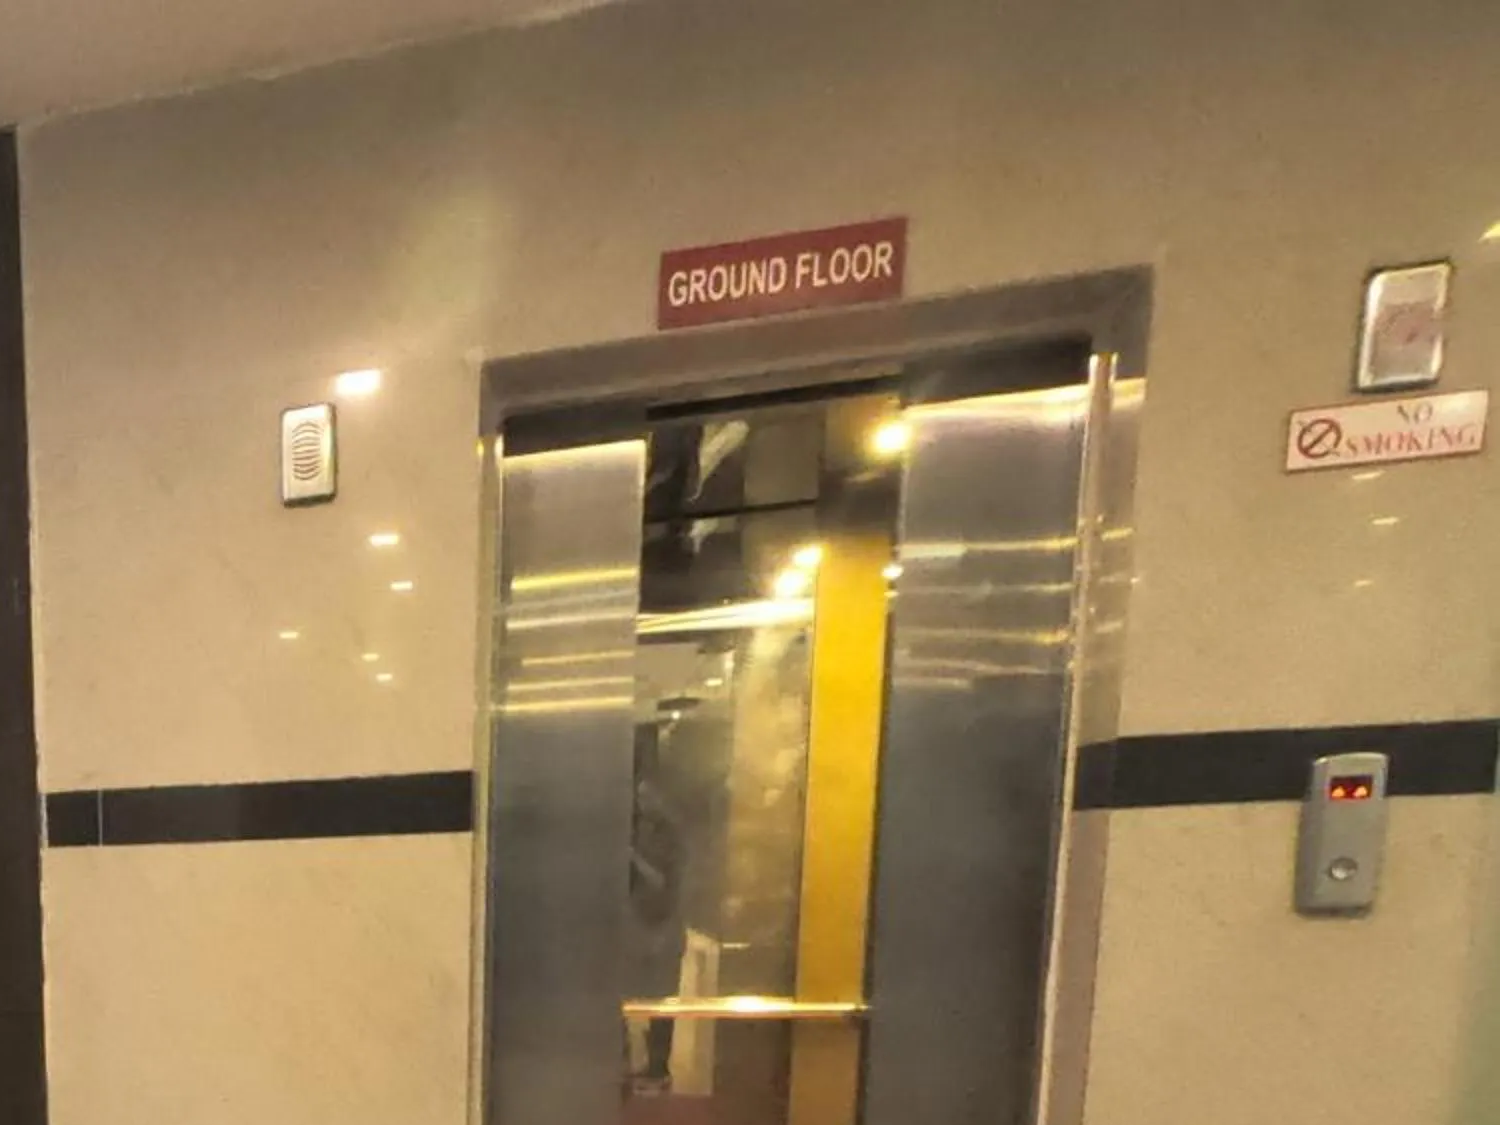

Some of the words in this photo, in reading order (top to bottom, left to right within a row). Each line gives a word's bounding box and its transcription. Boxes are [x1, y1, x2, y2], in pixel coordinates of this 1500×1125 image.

[668, 256, 787, 307] GROUND
[794, 241, 893, 289] FLOOR
[1396, 401, 1433, 424] NO
[1345, 423, 1478, 457] SMOKING
